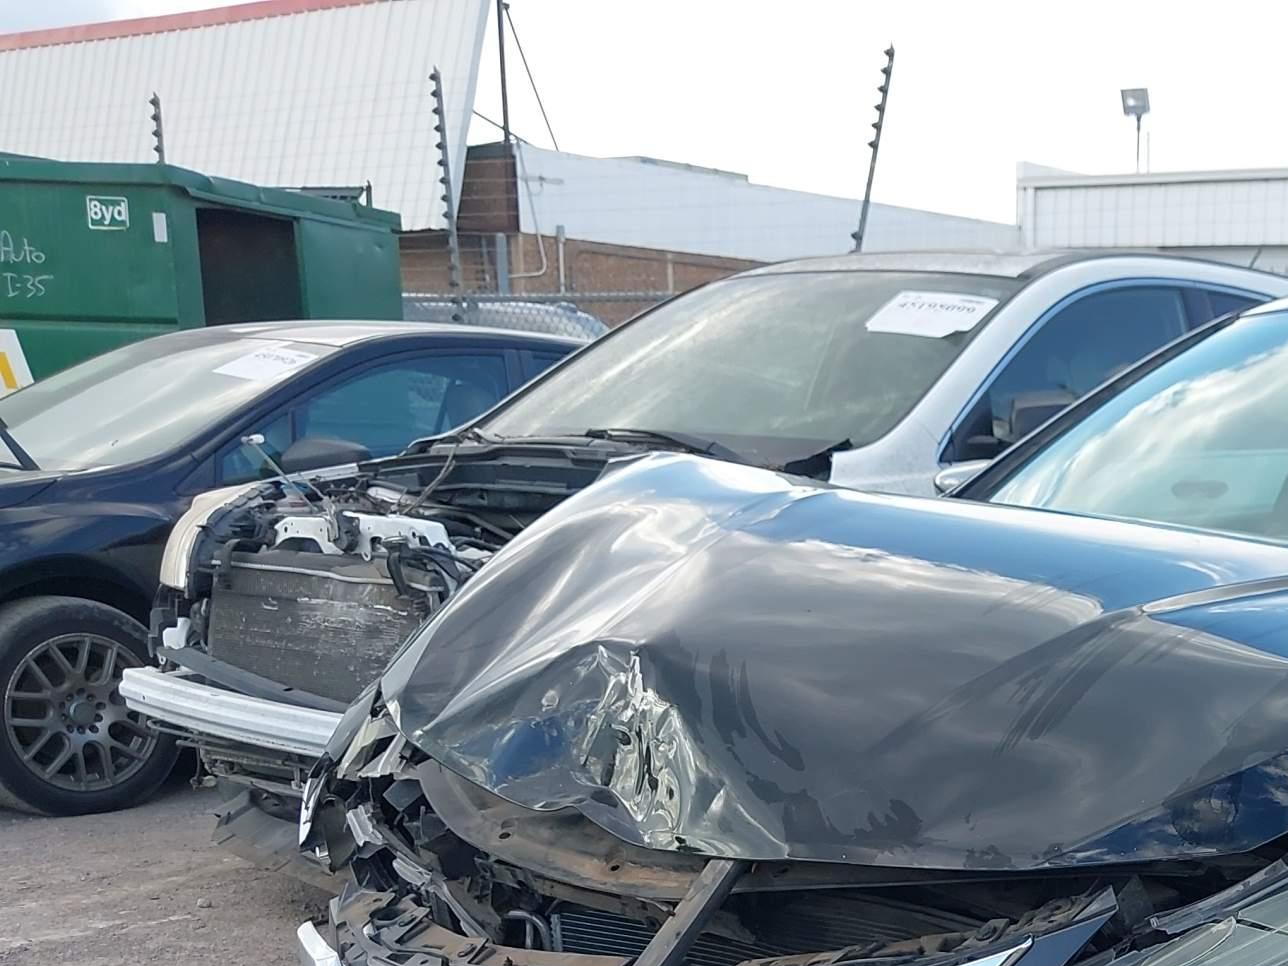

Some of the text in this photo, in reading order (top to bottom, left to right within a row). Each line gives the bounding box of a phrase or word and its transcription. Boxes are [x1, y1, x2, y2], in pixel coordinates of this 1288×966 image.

[90, 200, 127, 225] 8yd
[0, 230, 46, 263] Auto
[2, 273, 54, 298] I-35
